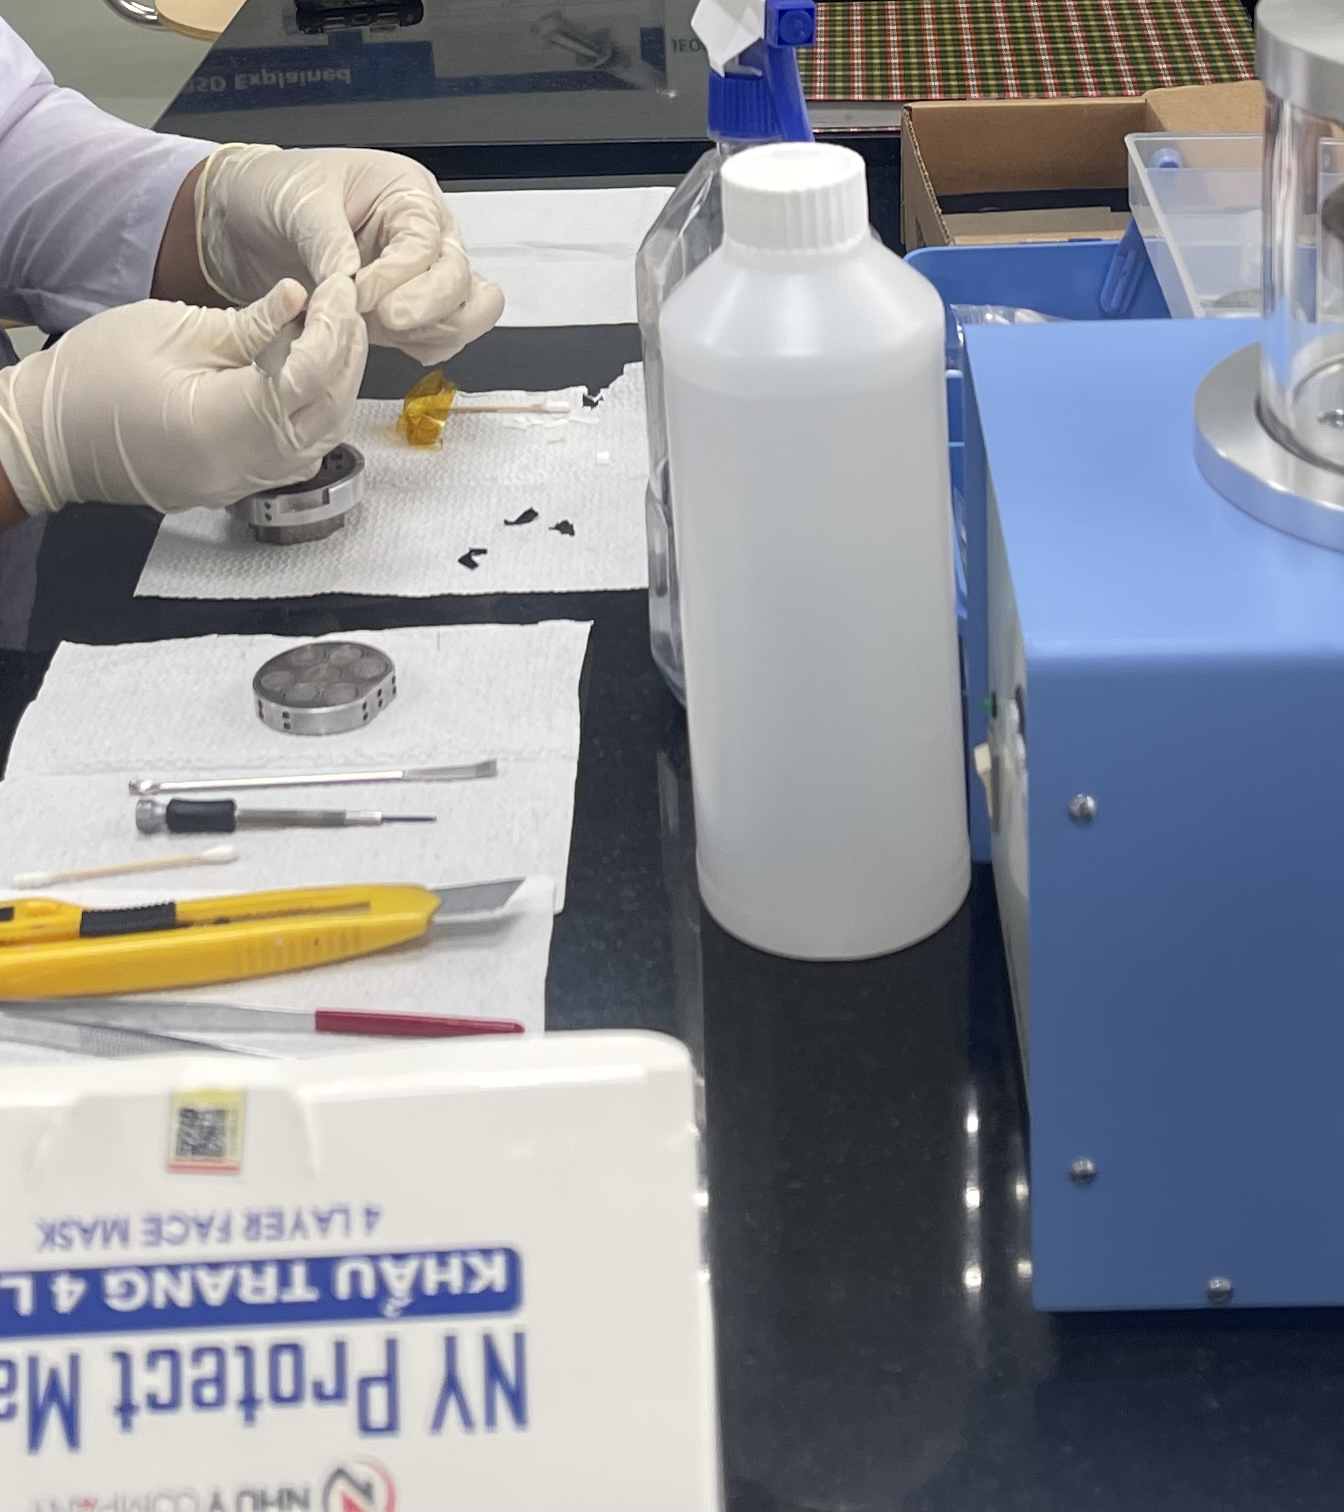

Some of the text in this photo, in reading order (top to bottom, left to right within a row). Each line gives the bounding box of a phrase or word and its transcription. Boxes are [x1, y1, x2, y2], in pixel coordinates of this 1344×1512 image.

[36, 1207, 382, 1252] 4 LAYER FACE MASK
[52, 1270, 86, 1314] 4
[106, 1258, 316, 1310] TRANG
[334, 1250, 509, 1314] KHẨU
[109, 1336, 401, 1439] Protect
[429, 1332, 531, 1437] NY
